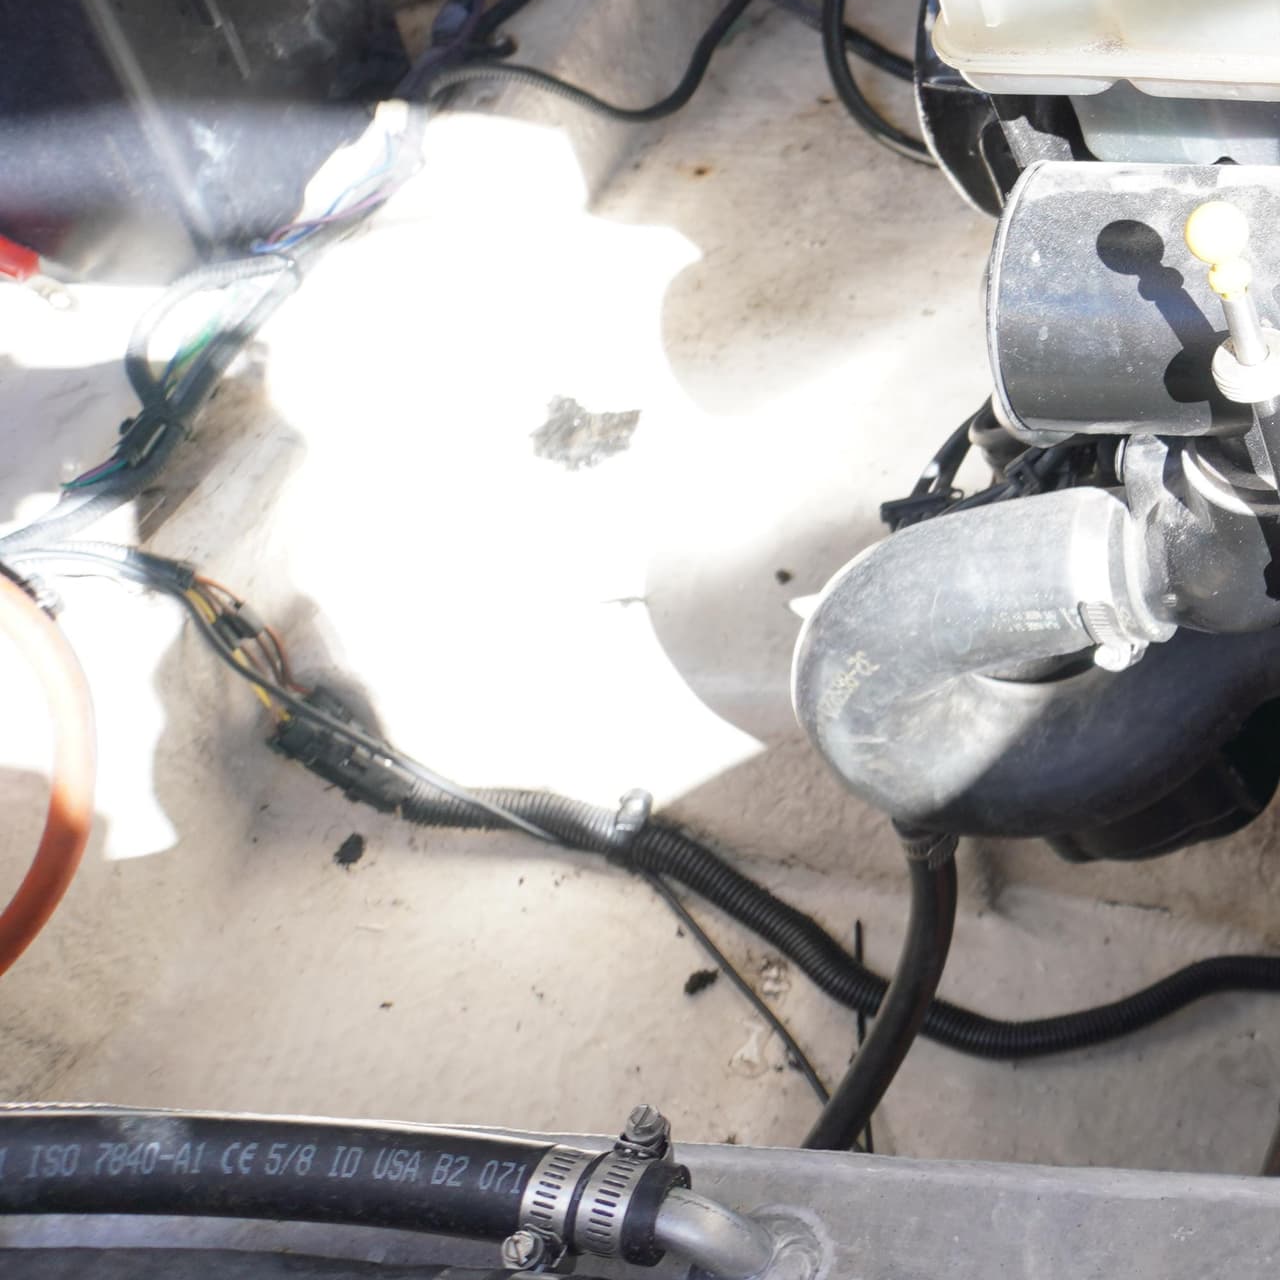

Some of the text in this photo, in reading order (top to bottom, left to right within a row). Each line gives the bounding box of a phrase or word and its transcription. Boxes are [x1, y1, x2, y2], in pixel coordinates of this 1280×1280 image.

[26, 1143, 81, 1179] ISO
[95, 1141, 207, 1177] 7840-A1
[221, 1142, 259, 1175] CE
[264, 1143, 319, 1177] 5/8
[327, 1145, 365, 1178] ID
[372, 1147, 420, 1183] USA
[431, 1152, 470, 1187] B2
[478, 1159, 528, 1195] 071
